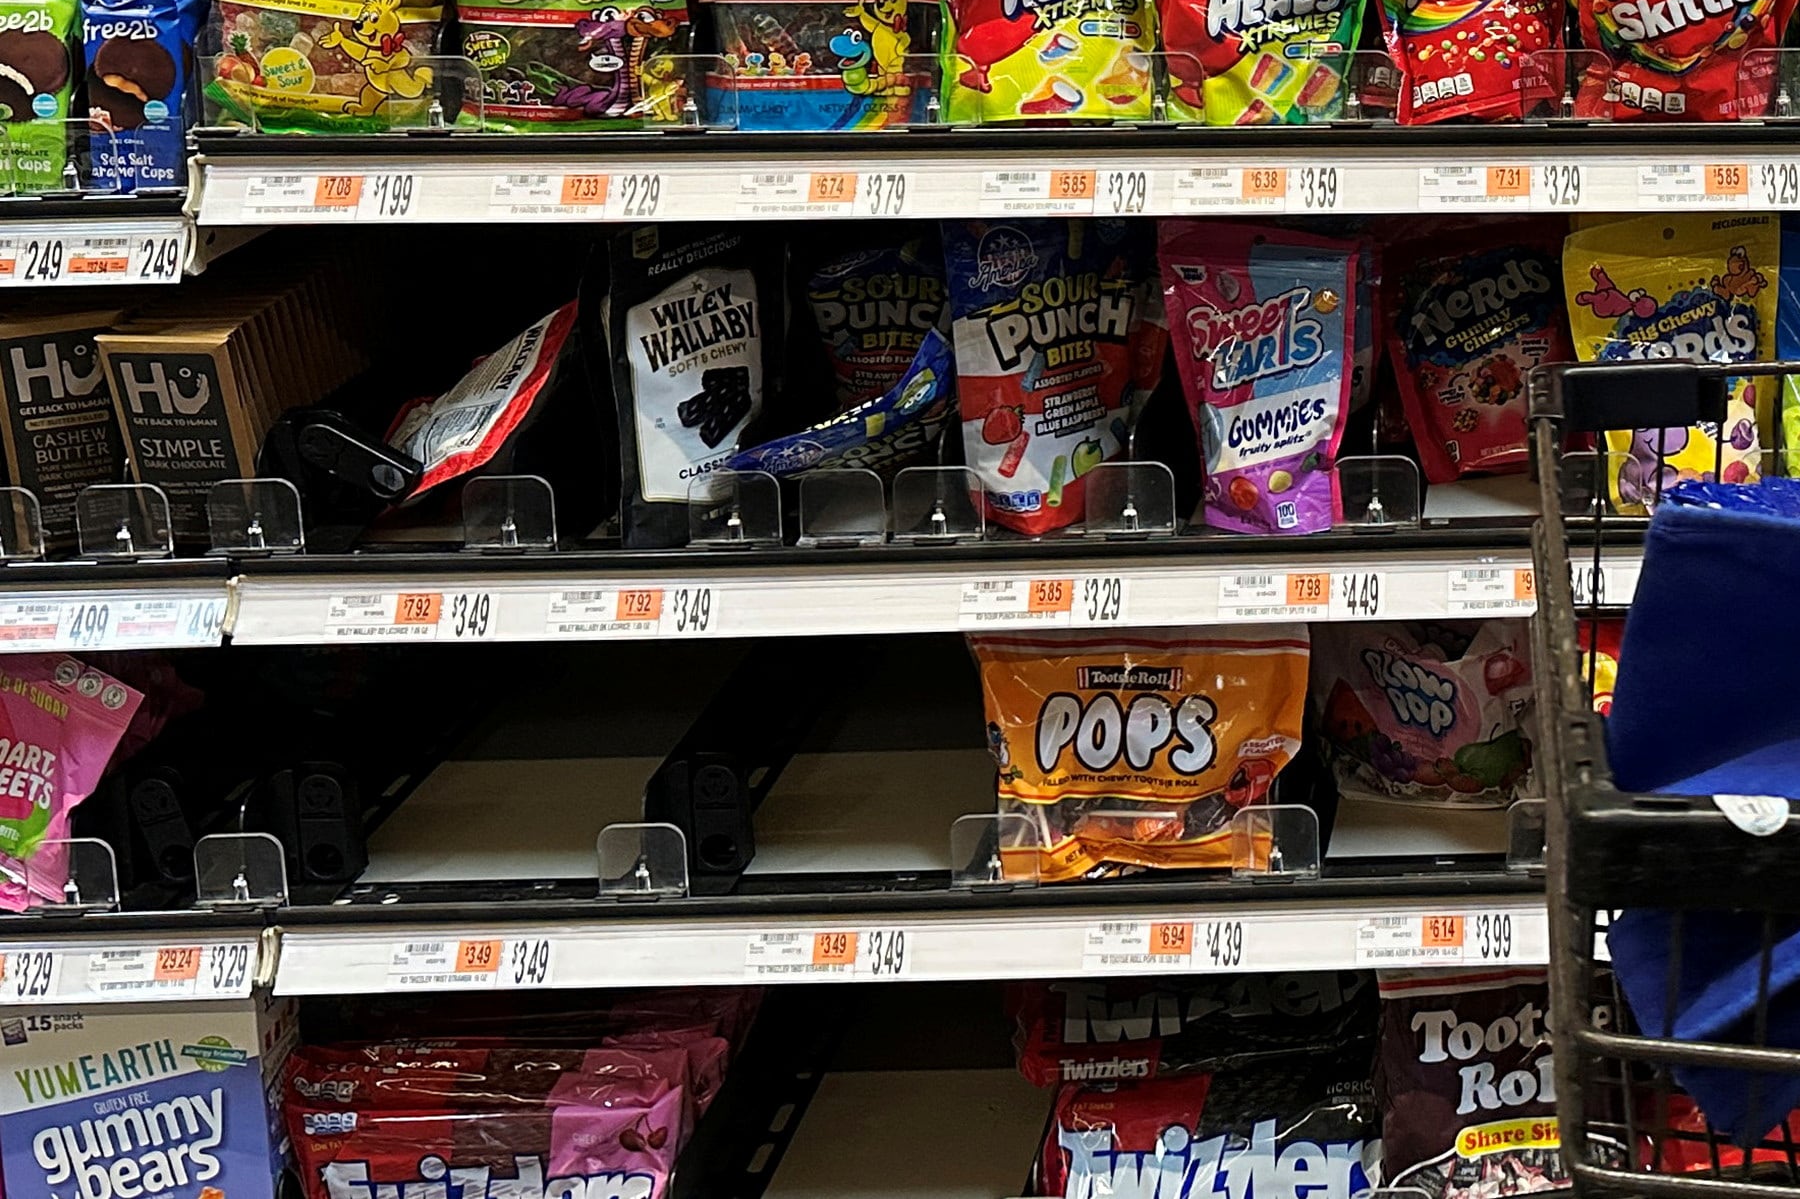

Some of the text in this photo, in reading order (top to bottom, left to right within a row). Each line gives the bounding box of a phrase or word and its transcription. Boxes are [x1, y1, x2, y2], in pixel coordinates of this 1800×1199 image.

[82, 18, 158, 41] free2b
[278, 74, 303, 88] Sour
[651, 283, 733, 327] WILEY
[1021, 274, 1097, 312] SOUR
[640, 301, 758, 371] WALLABY
[987, 297, 1132, 367] PUNCH
[1047, 340, 1092, 367] BITES
[1229, 399, 1326, 448] GUMMIES
[34, 427, 108, 448] CASHEW
[141, 438, 225, 460] SIMPLE
[36, 443, 110, 463] BUTTER
[1090, 670, 1169, 685] Tootsie Roll
[14, 681, 68, 719] OF SUGAR
[1037, 695, 1216, 772] POPS
[27, 1016, 50, 1032] 15
[53, 1012, 83, 1021] snack
[53, 1021, 83, 1032] packs
[15, 1039, 178, 1101] YUMEARTH
[1060, 1057, 1148, 1083] Twizzlers
[94, 1091, 151, 1111] GLUTEN FREE
[33, 1089, 223, 1183] gummy
[1465, 1125, 1519, 1150] Share
[74, 1137, 222, 1199] bears
